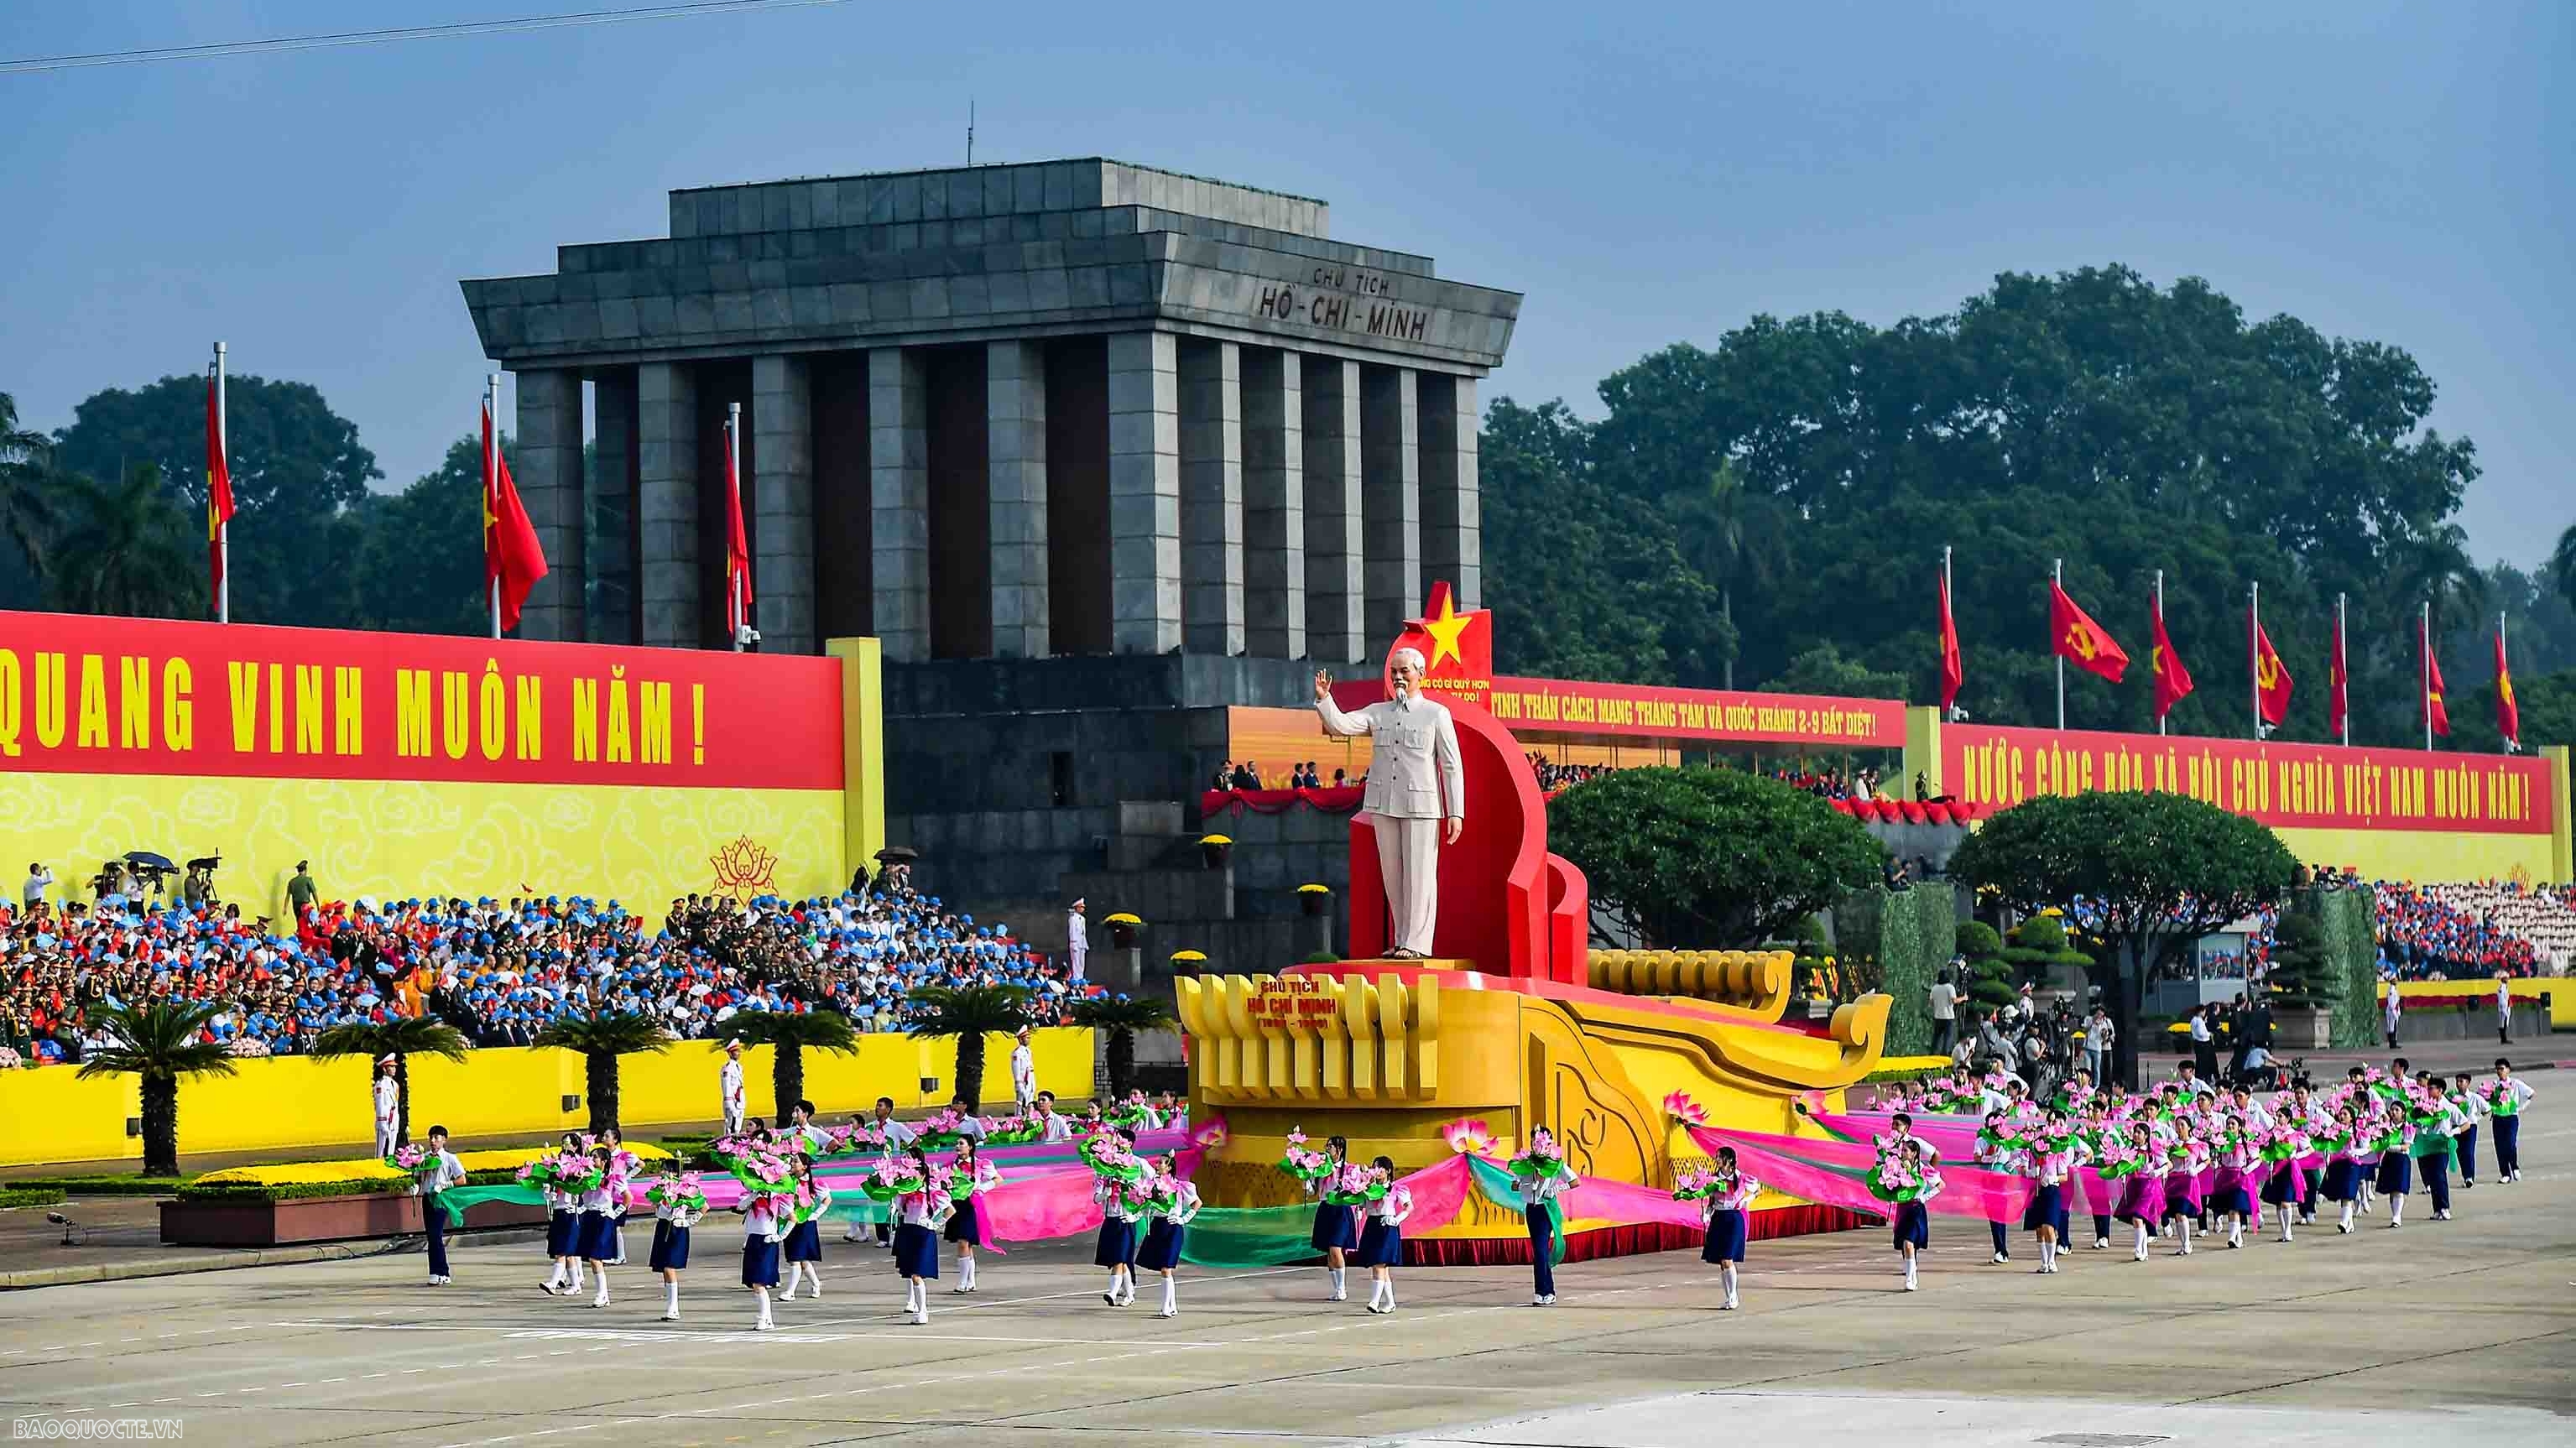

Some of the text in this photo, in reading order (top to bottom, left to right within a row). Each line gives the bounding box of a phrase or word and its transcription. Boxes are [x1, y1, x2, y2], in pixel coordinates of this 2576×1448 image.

[0, 648, 193, 757] QUANG
[227, 661, 362, 756] VINH
[396, 657, 542, 761] MUÔN
[1523, 686, 1559, 721] THẦN
[1562, 691, 1596, 723] CÁCH
[1598, 697, 1633, 729] MẠNG
[1635, 698, 1676, 728] THÁNG
[1678, 699, 1706, 729] TÁM
[1707, 700, 1723, 731] VÀ
[1725, 700, 1755, 732] QUỐC
[1758, 704, 1796, 733] KHÁNH
[1822, 705, 1844, 736] BẤT
[1963, 737, 2024, 805] NƯỚC
[2232, 747, 2270, 813] CHỦ
[2279, 753, 2336, 815] NGHĨA
[2344, 756, 2382, 826] VIỆT
[2390, 766, 2426, 818] NAM
[2434, 760, 2480, 820] MUÔN
[1260, 977, 1321, 995] CHỦ TỊCH
